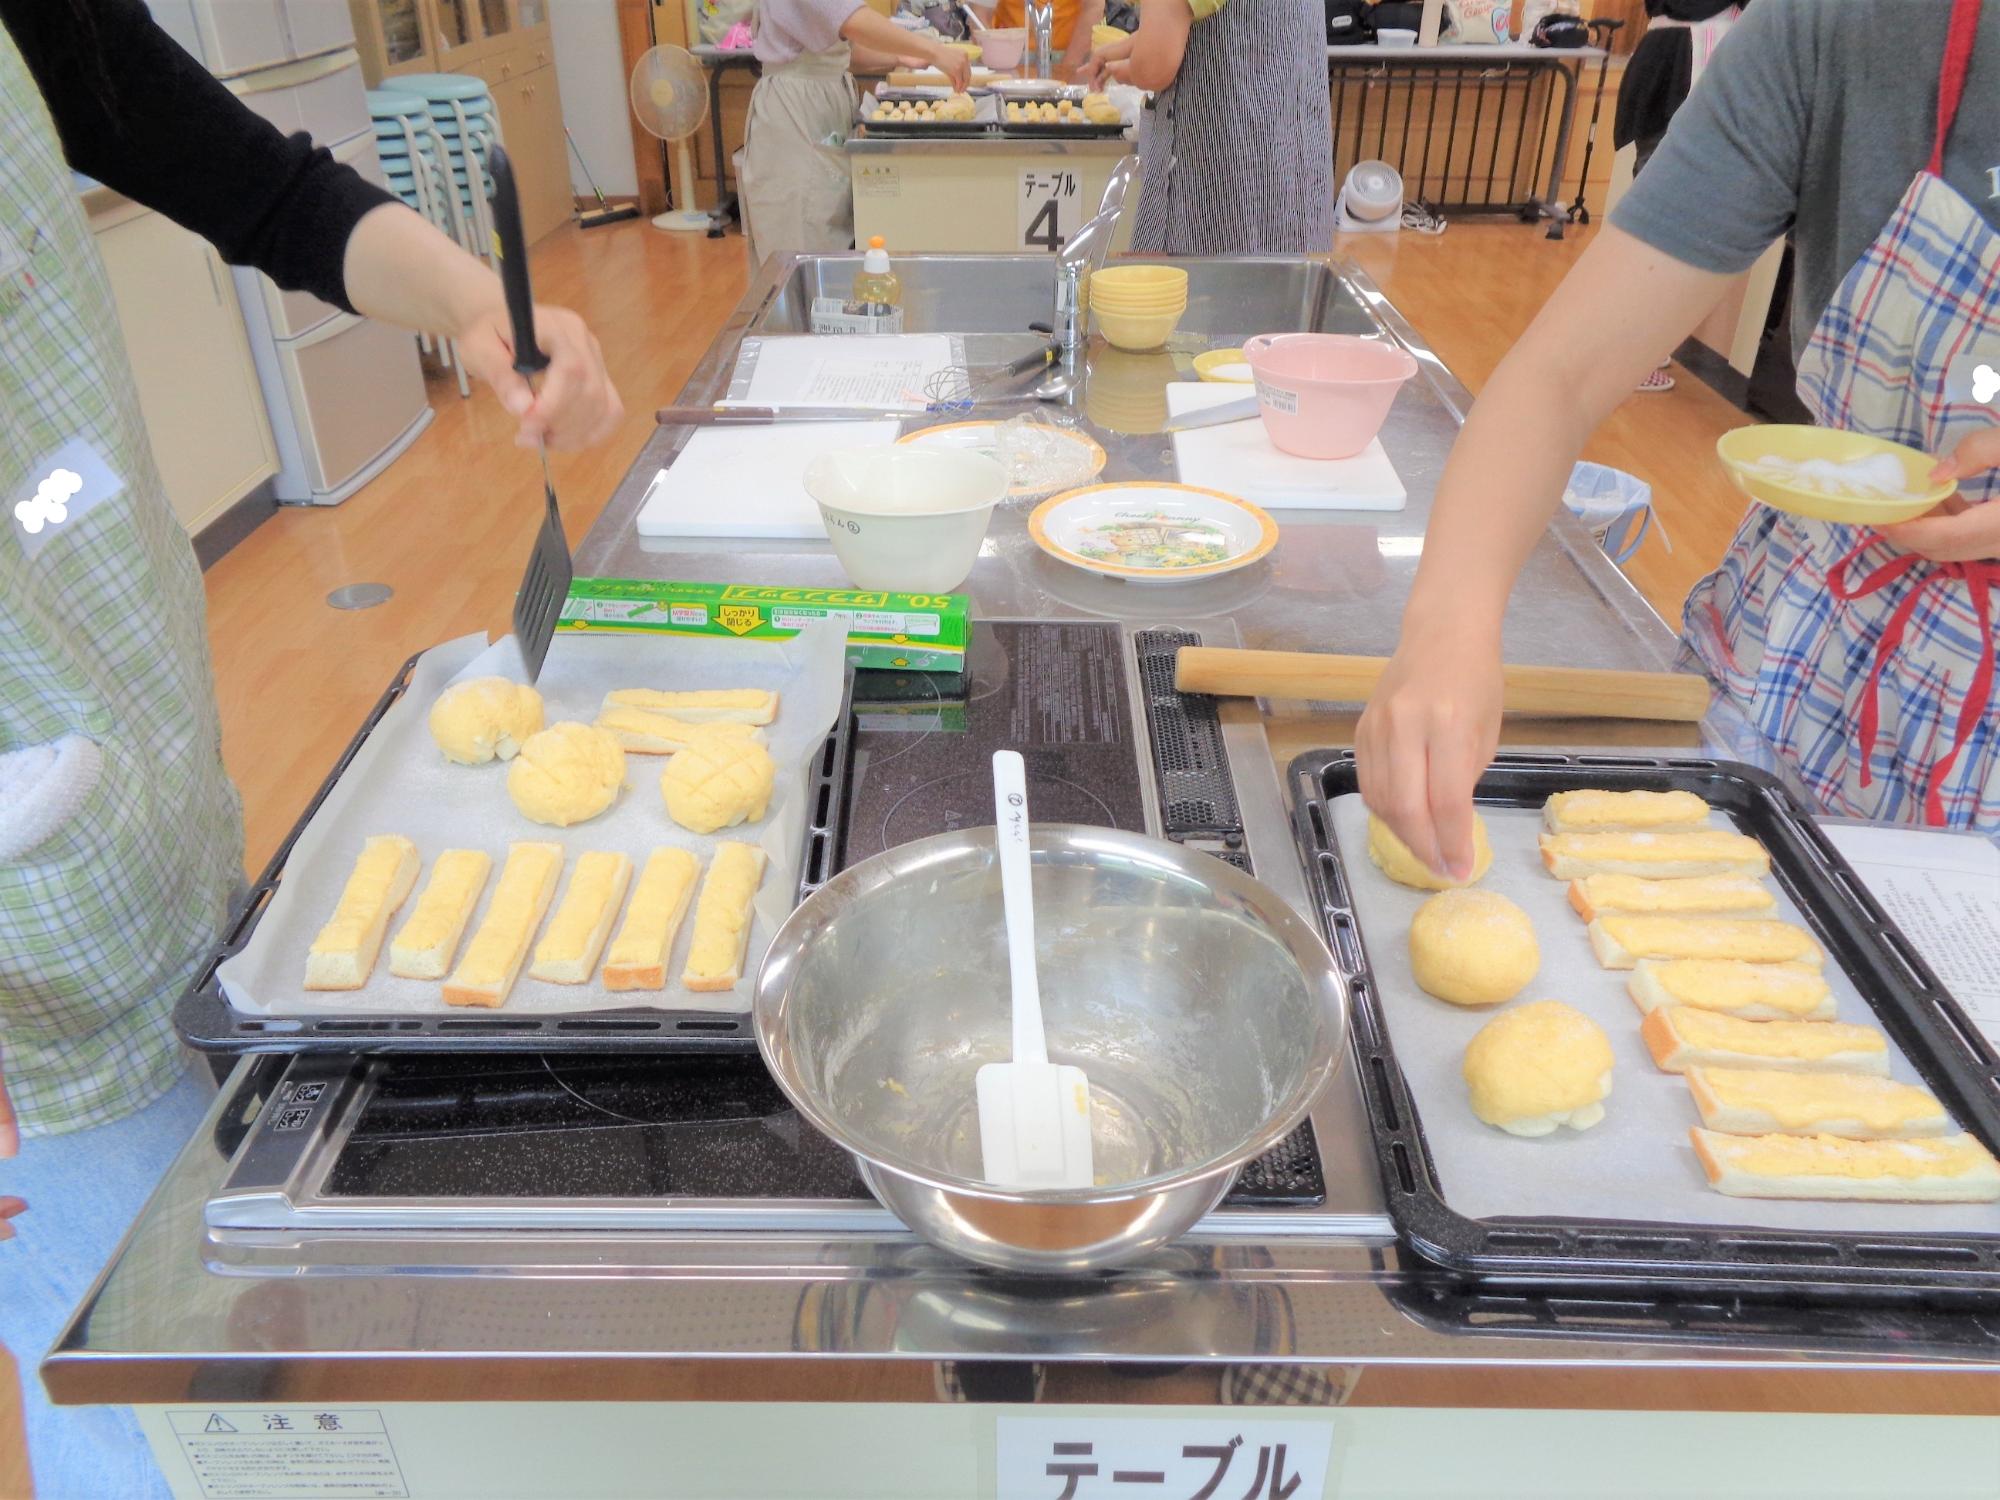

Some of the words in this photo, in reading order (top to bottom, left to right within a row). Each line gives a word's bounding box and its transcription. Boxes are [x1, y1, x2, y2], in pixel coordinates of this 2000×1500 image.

[1025, 171, 1076, 198] テーブル
[1025, 199, 1065, 251] 4
[731, 588, 878, 604] サランラップ
[723, 608, 755, 617] しっかり
[726, 617, 752, 627] 閉じる
[262, 1413, 343, 1431] 注意
[1046, 1433, 1302, 1500] テーブル
